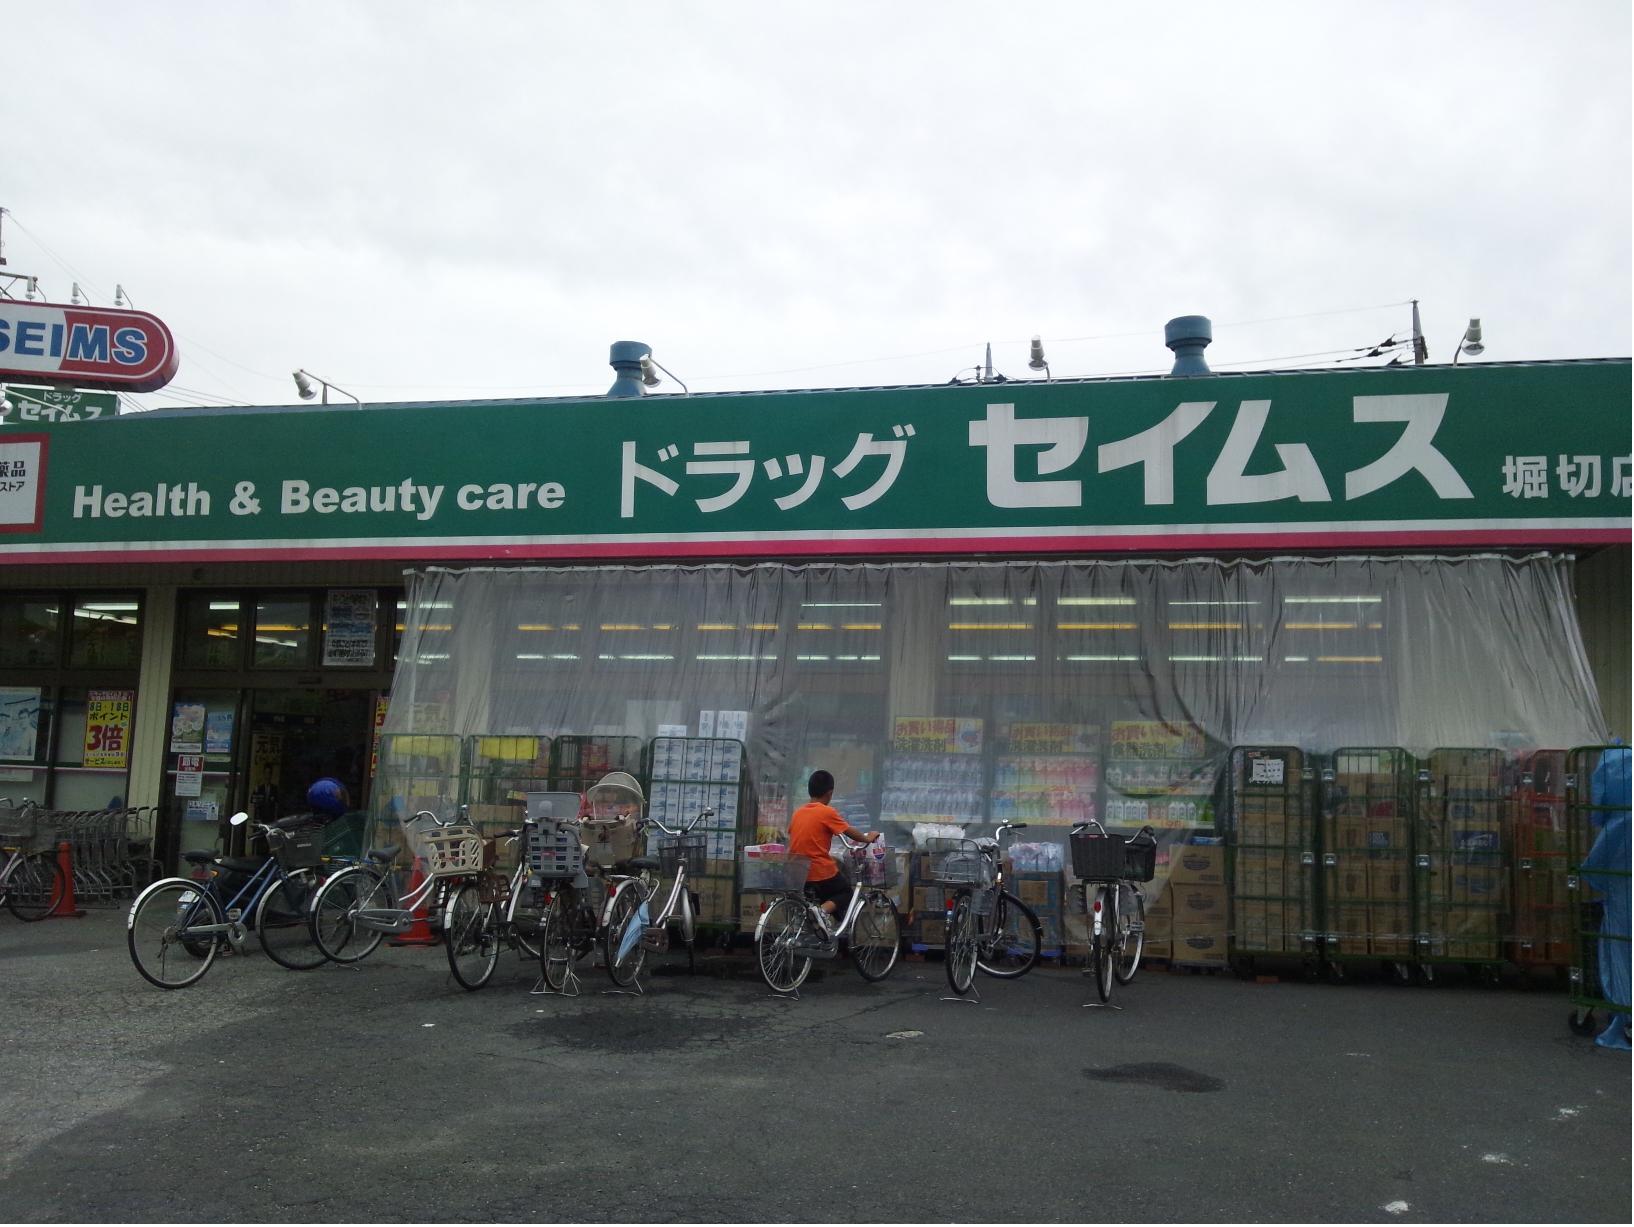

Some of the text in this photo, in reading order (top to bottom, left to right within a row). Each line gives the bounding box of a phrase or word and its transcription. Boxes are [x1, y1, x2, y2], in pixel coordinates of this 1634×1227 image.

[621, 423, 916, 518] ドラッグ
[969, 392, 1475, 508] セイムス
[73, 477, 566, 520] Health & Beauty care
[90, 712, 128, 720] ポイント
[87, 724, 123, 751] 3倍
